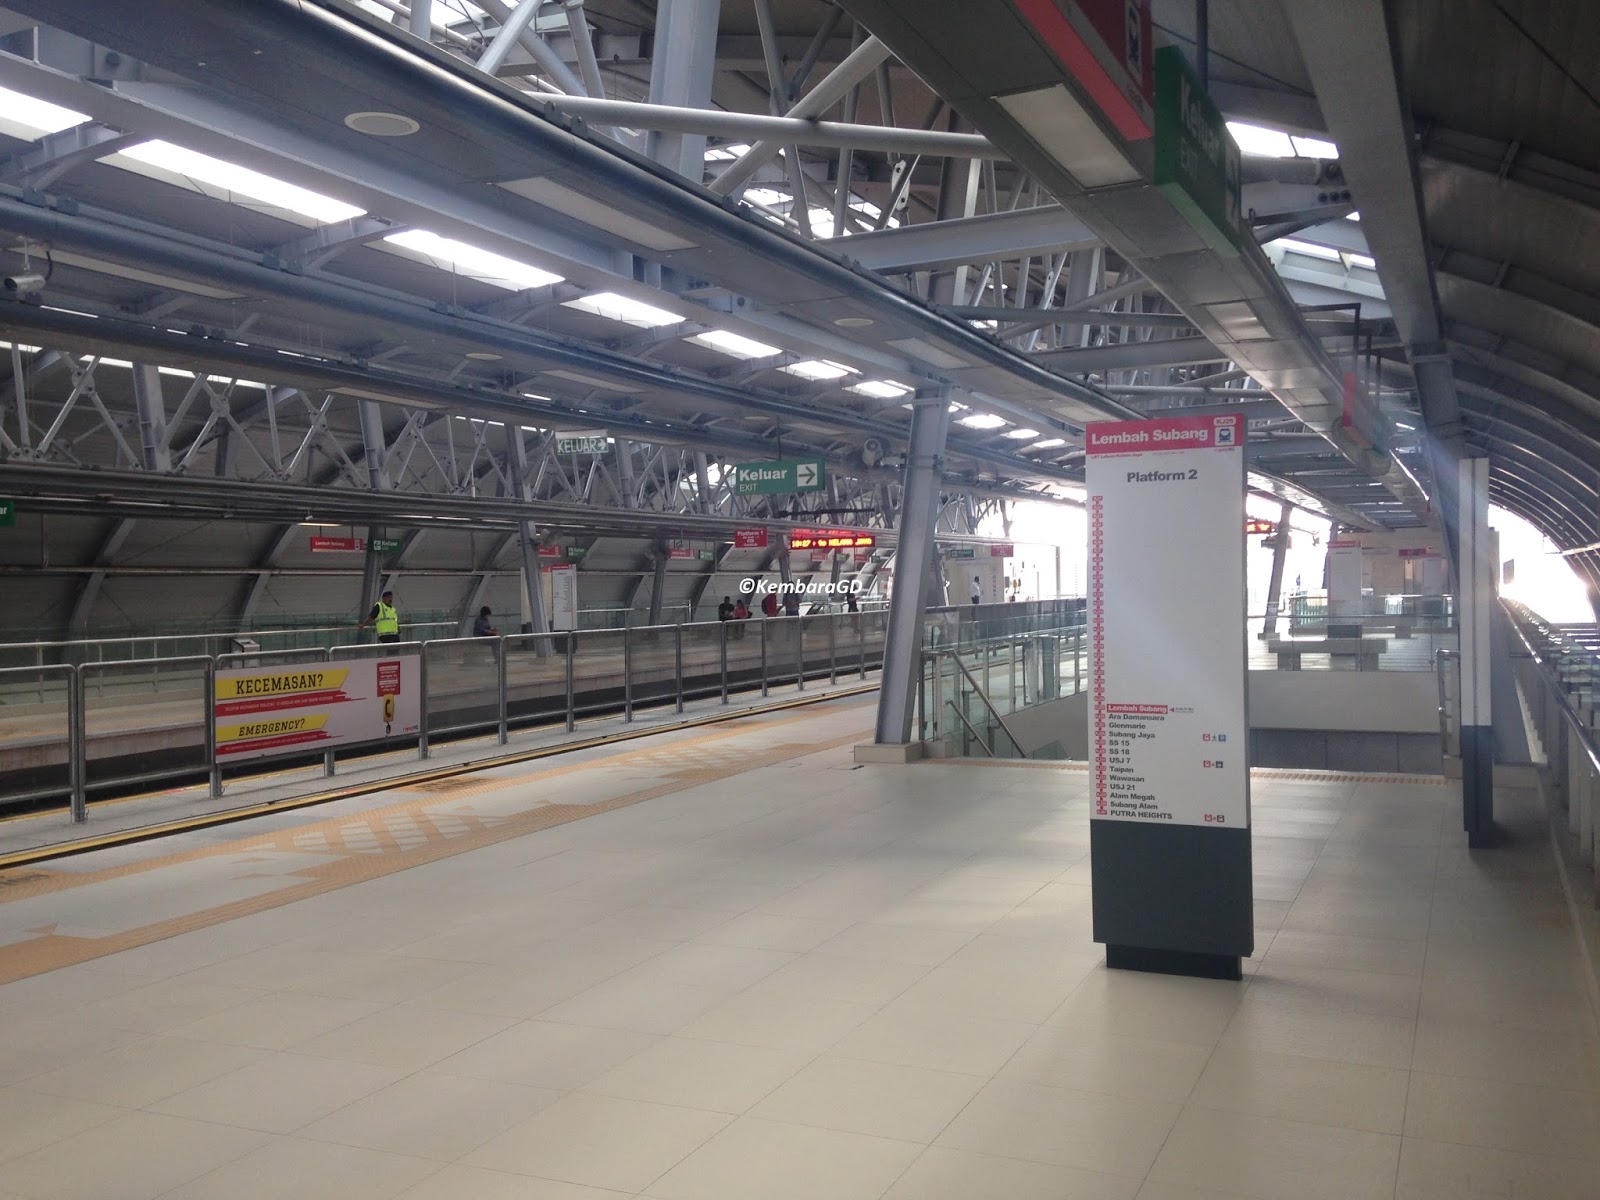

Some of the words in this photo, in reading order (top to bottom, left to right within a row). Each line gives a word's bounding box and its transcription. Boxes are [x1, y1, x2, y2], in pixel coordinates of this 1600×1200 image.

[1091, 430, 1149, 445] Lembah
[1152, 428, 1208, 442] Subang
[557, 438, 597, 454] KELUAR
[740, 468, 787, 481] Keluar
[1127, 471, 1185, 482] Platform
[1188, 469, 1198, 480] 2
[740, 483, 757, 492] EXIT
[236, 673, 324, 695] KECEMASAN?
[1108, 704, 1138, 713] Lembah
[1139, 705, 1167, 714] Subang
[238, 718, 305, 737] EMERGENCY?
[1109, 730, 1136, 739] Subang
[1137, 731, 1156, 739] Jaya
[1130, 793, 1155, 801] Megah
[1110, 801, 1137, 809] Subang
[1139, 802, 1158, 810] Alam
[1110, 810, 1136, 818] PUTRA
[1138, 811, 1172, 820] HEIGHTS
